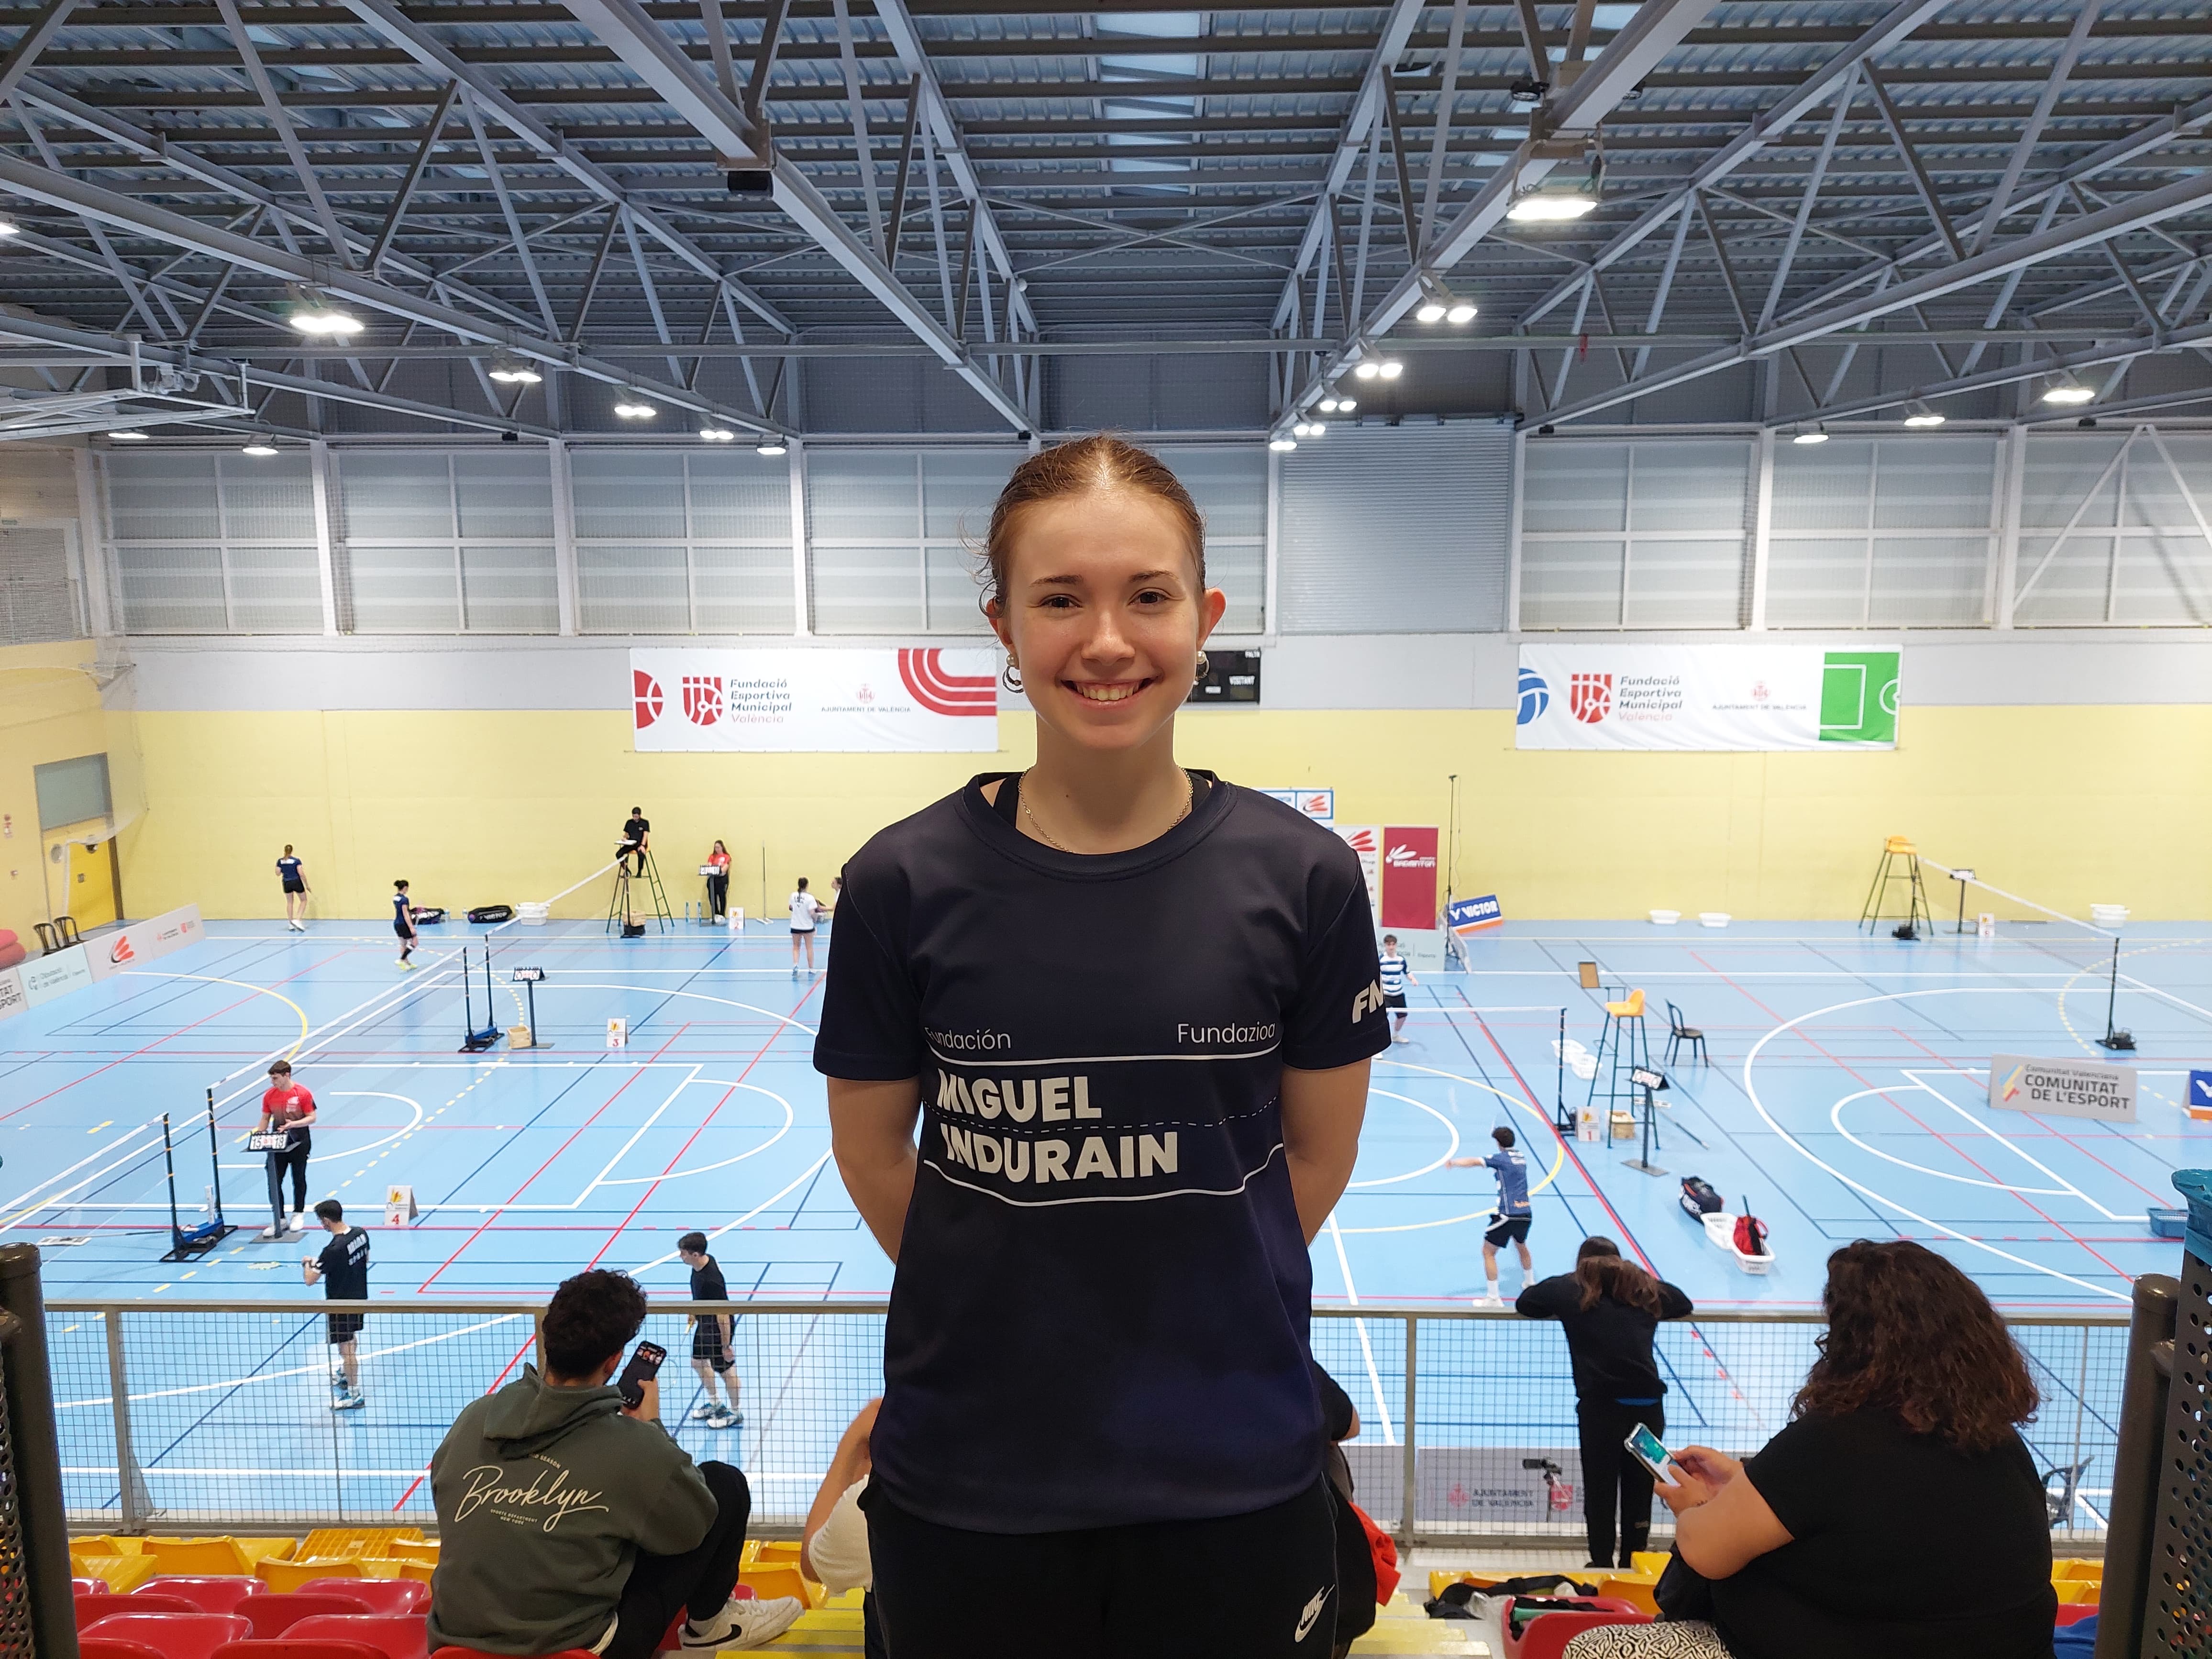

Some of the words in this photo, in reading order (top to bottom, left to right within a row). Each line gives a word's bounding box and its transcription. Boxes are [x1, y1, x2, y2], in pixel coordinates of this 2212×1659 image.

[730, 678, 787, 688] Fundació
[1620, 675, 1680, 686] Fundació
[731, 690, 790, 702] Esportiva
[1620, 687, 1681, 699] Esportiva
[731, 701, 792, 714] Municipal
[1619, 699, 1683, 712] Municipal
[1461, 901, 1498, 918] VICTOR
[0, 992, 22, 1009] PORT
[1178, 1021, 1276, 1043] Fundazioa
[2026, 1064, 2069, 1075] Comunitat
[2072, 1069, 2119, 1080] Valenciana
[2025, 1074, 2118, 1095] COMUNITAT
[937, 1067, 1102, 1123] MIGUEL
[2032, 1088, 2051, 1101] DE
[2056, 1091, 2131, 1109] L'ESPORT
[940, 1123, 1178, 1183] INDURAIN
[391, 1214, 399, 1225] 4
[540, 1455, 561, 1470] SEASON
[454, 1465, 609, 1533] Brooklyn
